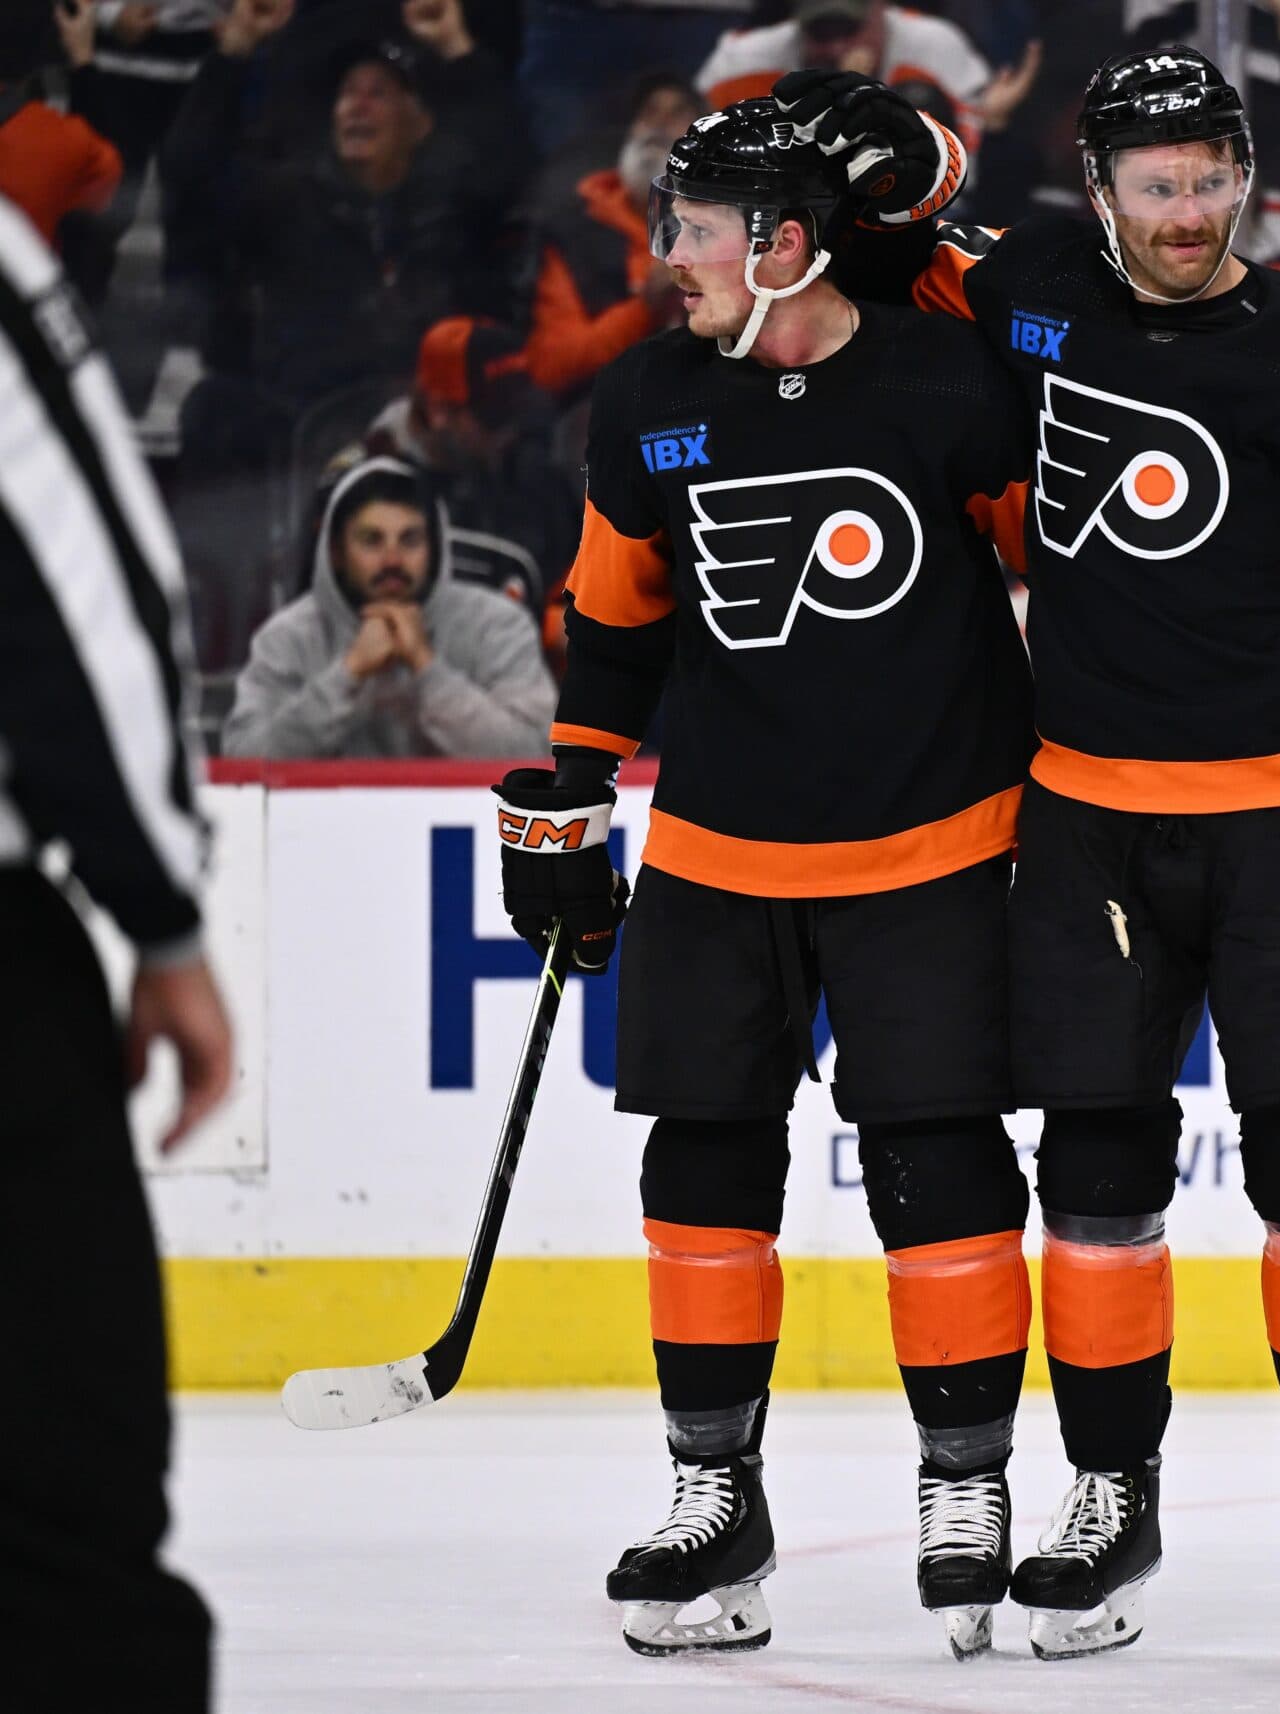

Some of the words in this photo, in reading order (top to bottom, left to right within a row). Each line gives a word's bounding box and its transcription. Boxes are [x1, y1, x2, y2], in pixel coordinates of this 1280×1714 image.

[1144, 55, 1179, 73] 14
[1010, 319, 1068, 362] IBX
[640, 425, 697, 442] Independence
[641, 433, 712, 473] IBX
[497, 808, 590, 850] CM
[582, 929, 613, 942] CCM
